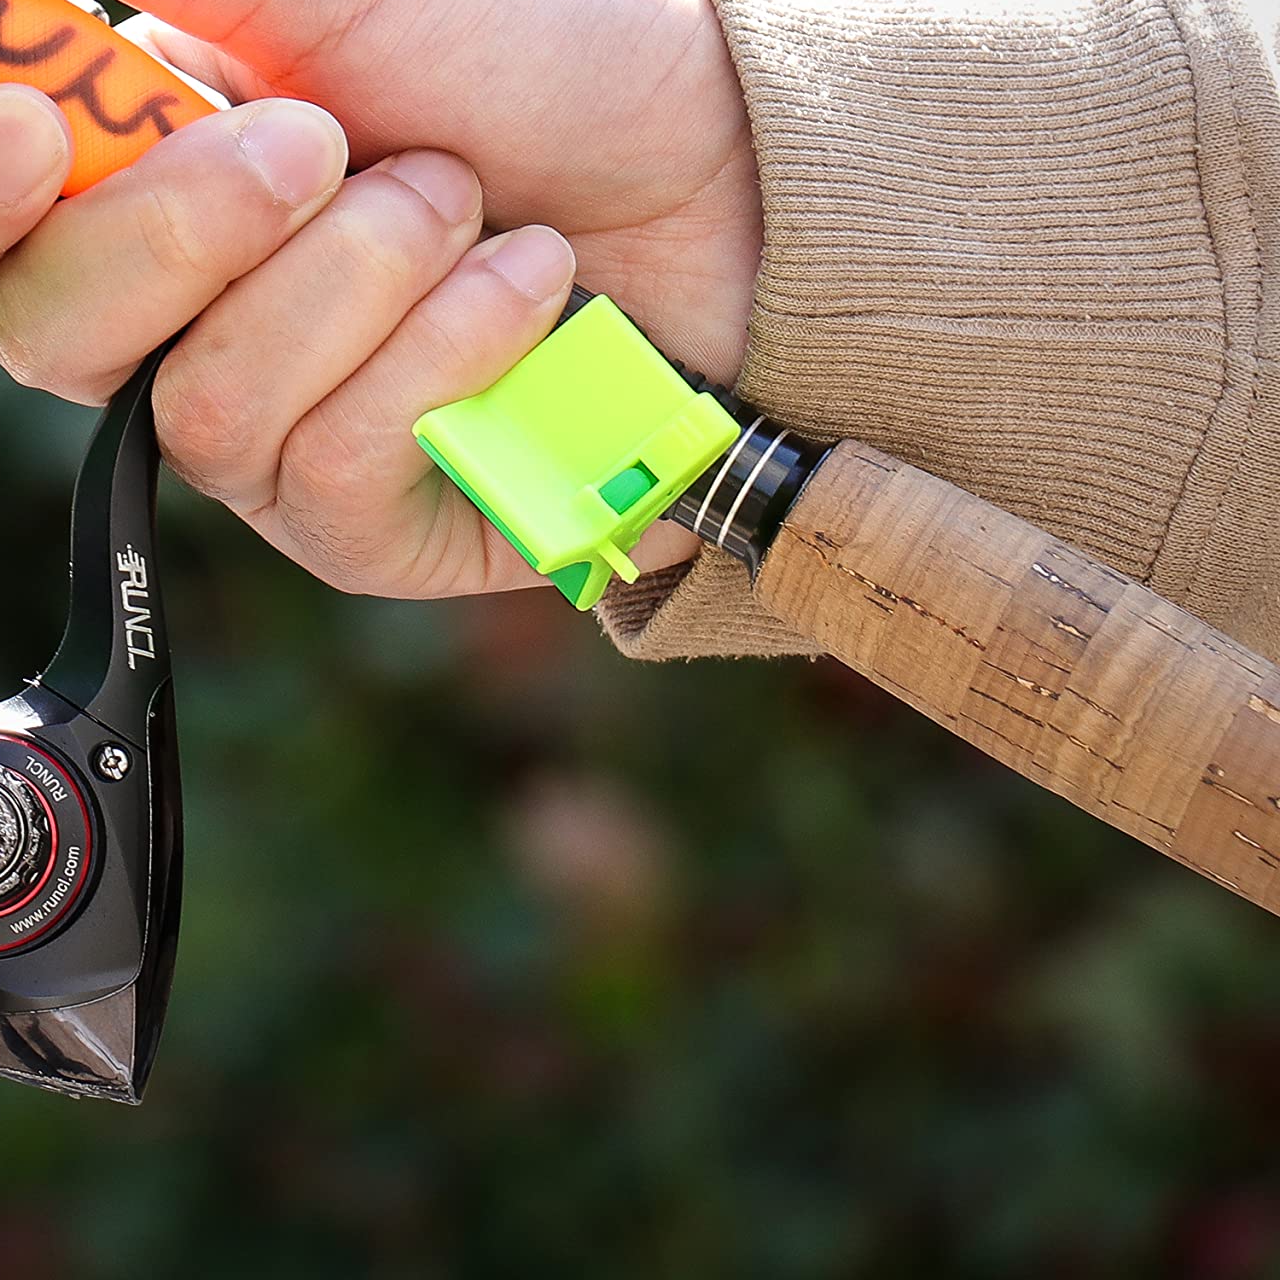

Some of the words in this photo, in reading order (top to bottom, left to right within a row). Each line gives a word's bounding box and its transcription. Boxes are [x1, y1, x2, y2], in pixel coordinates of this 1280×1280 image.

[117, 550, 156, 670] RUNCL
[24, 755, 68, 803] RUNCL
[9, 846, 81, 935] www.runcl.com
